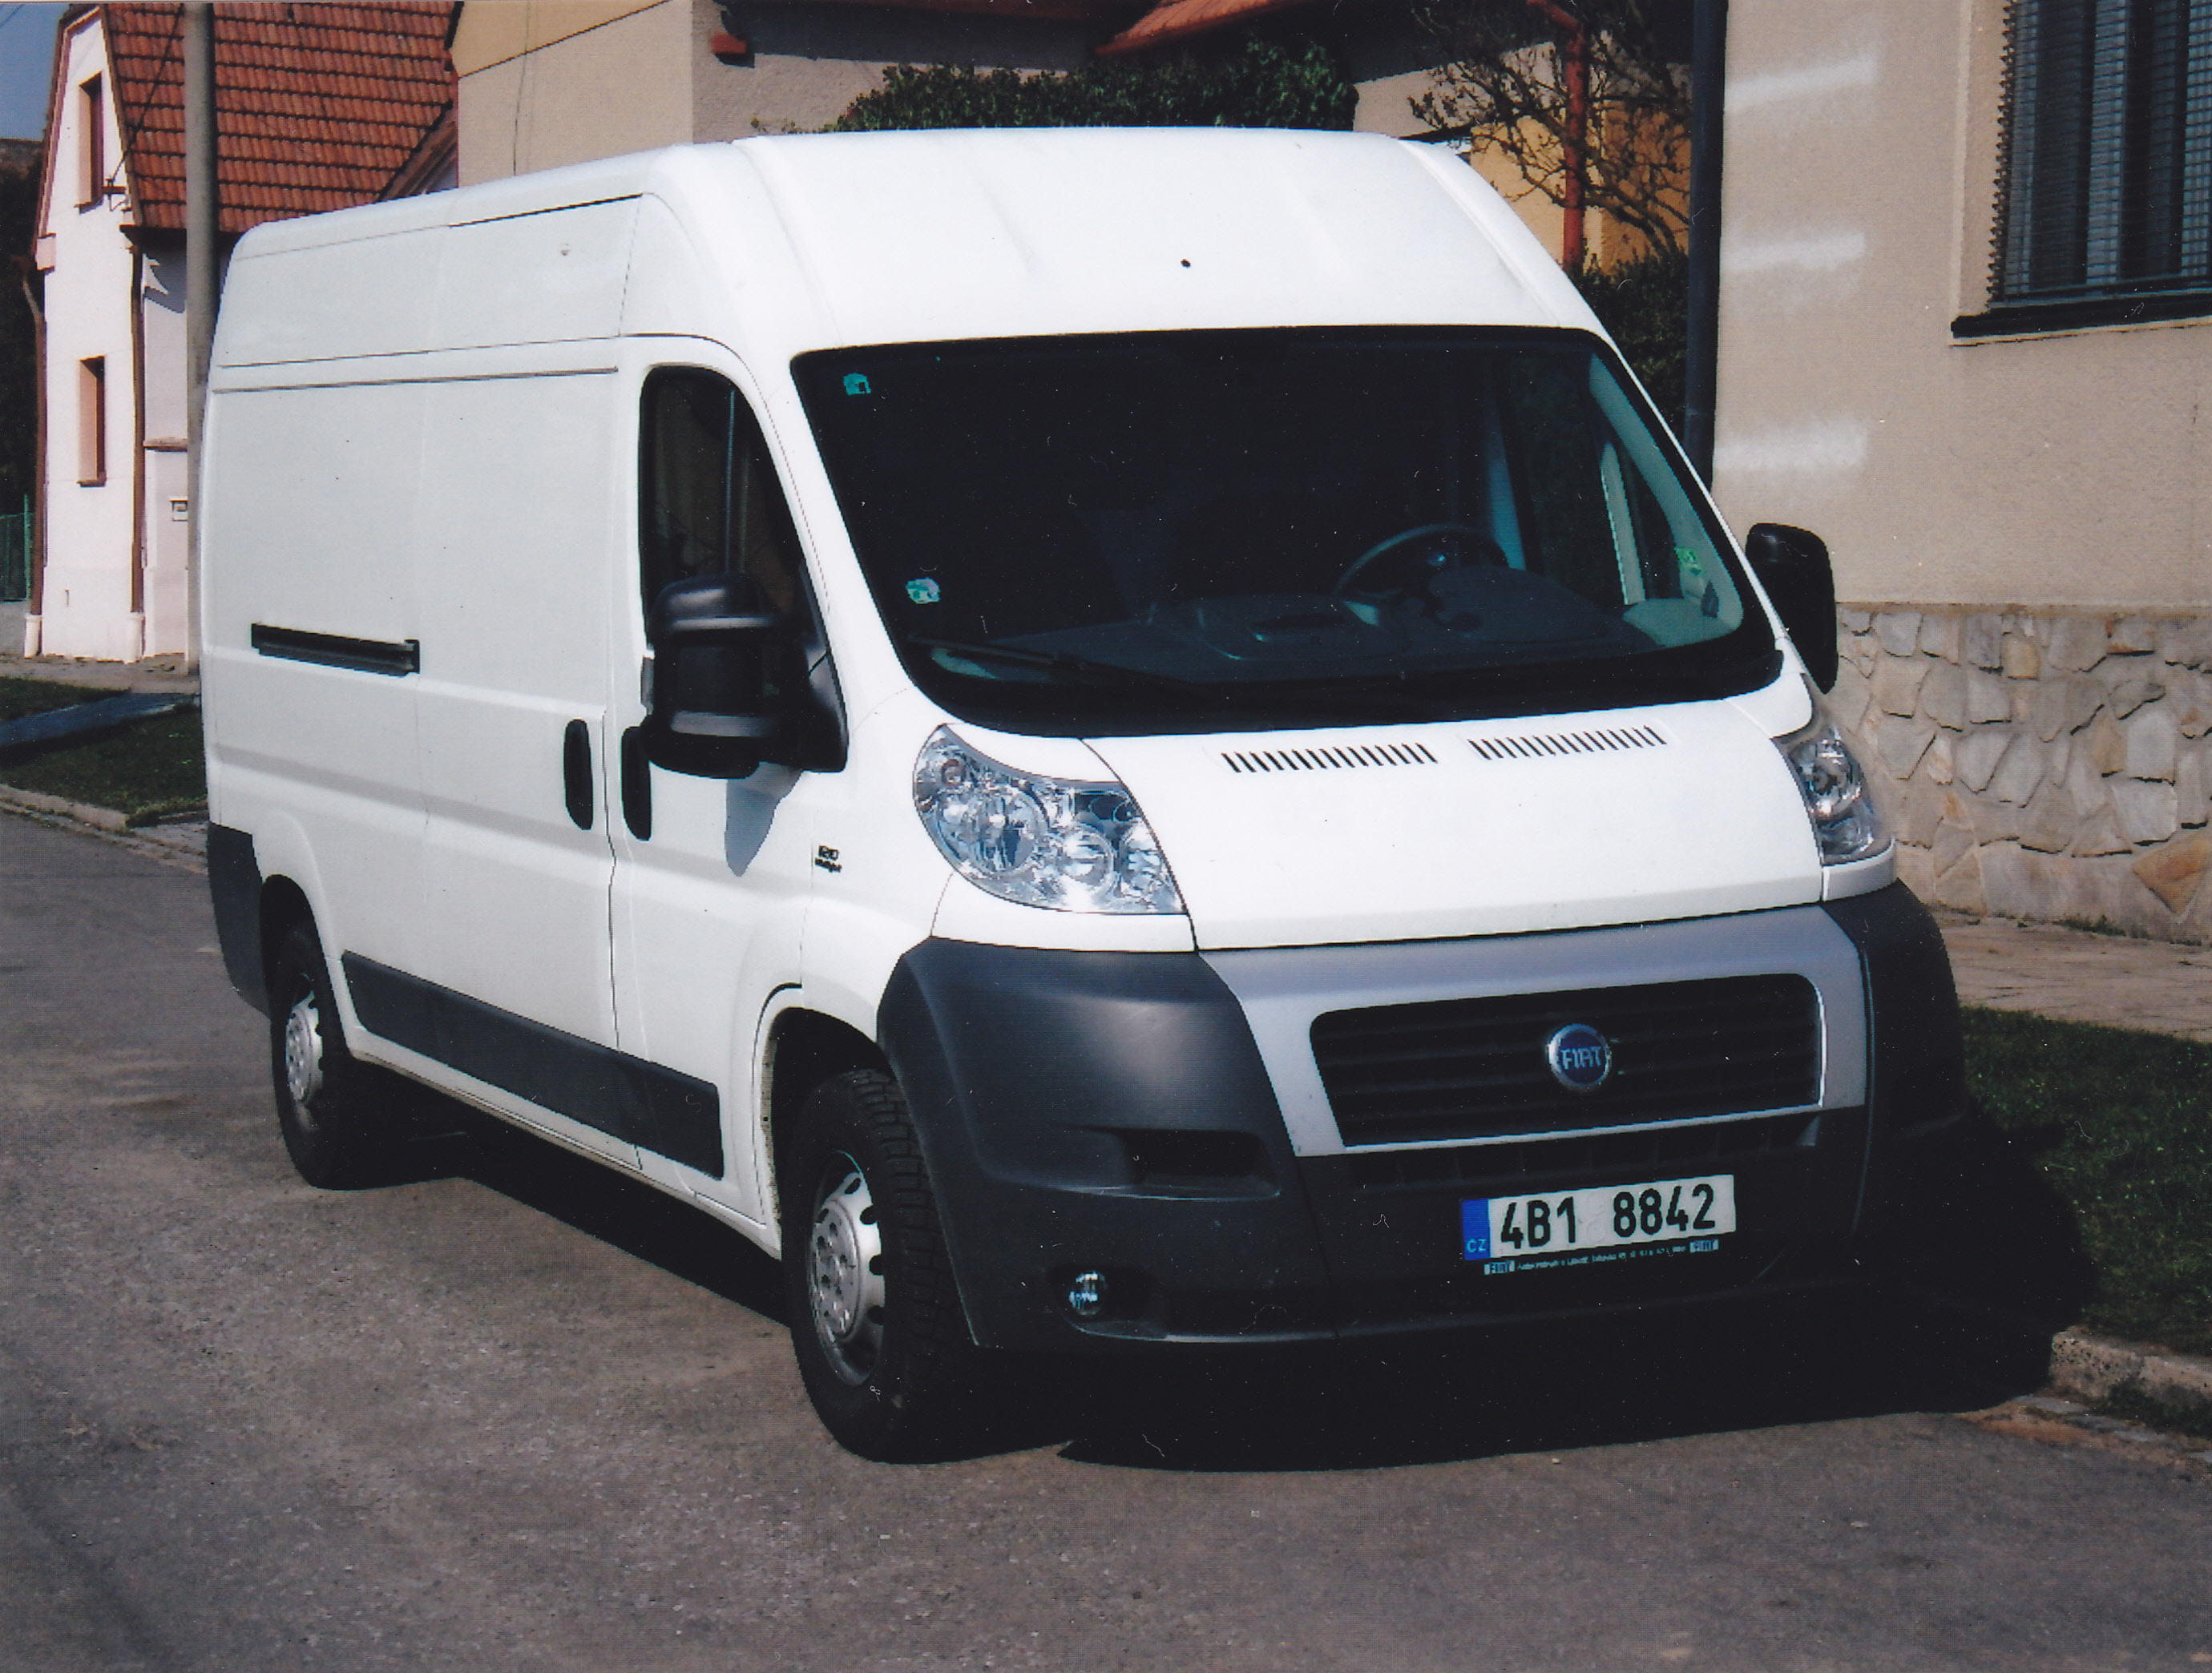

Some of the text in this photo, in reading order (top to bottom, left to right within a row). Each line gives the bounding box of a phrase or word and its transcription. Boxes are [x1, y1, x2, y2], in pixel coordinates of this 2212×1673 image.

[1560, 1045, 1602, 1070] FIAT
[1500, 1183, 1716, 1249] 4B1 8842
[1466, 1238, 1487, 1253] CZ
